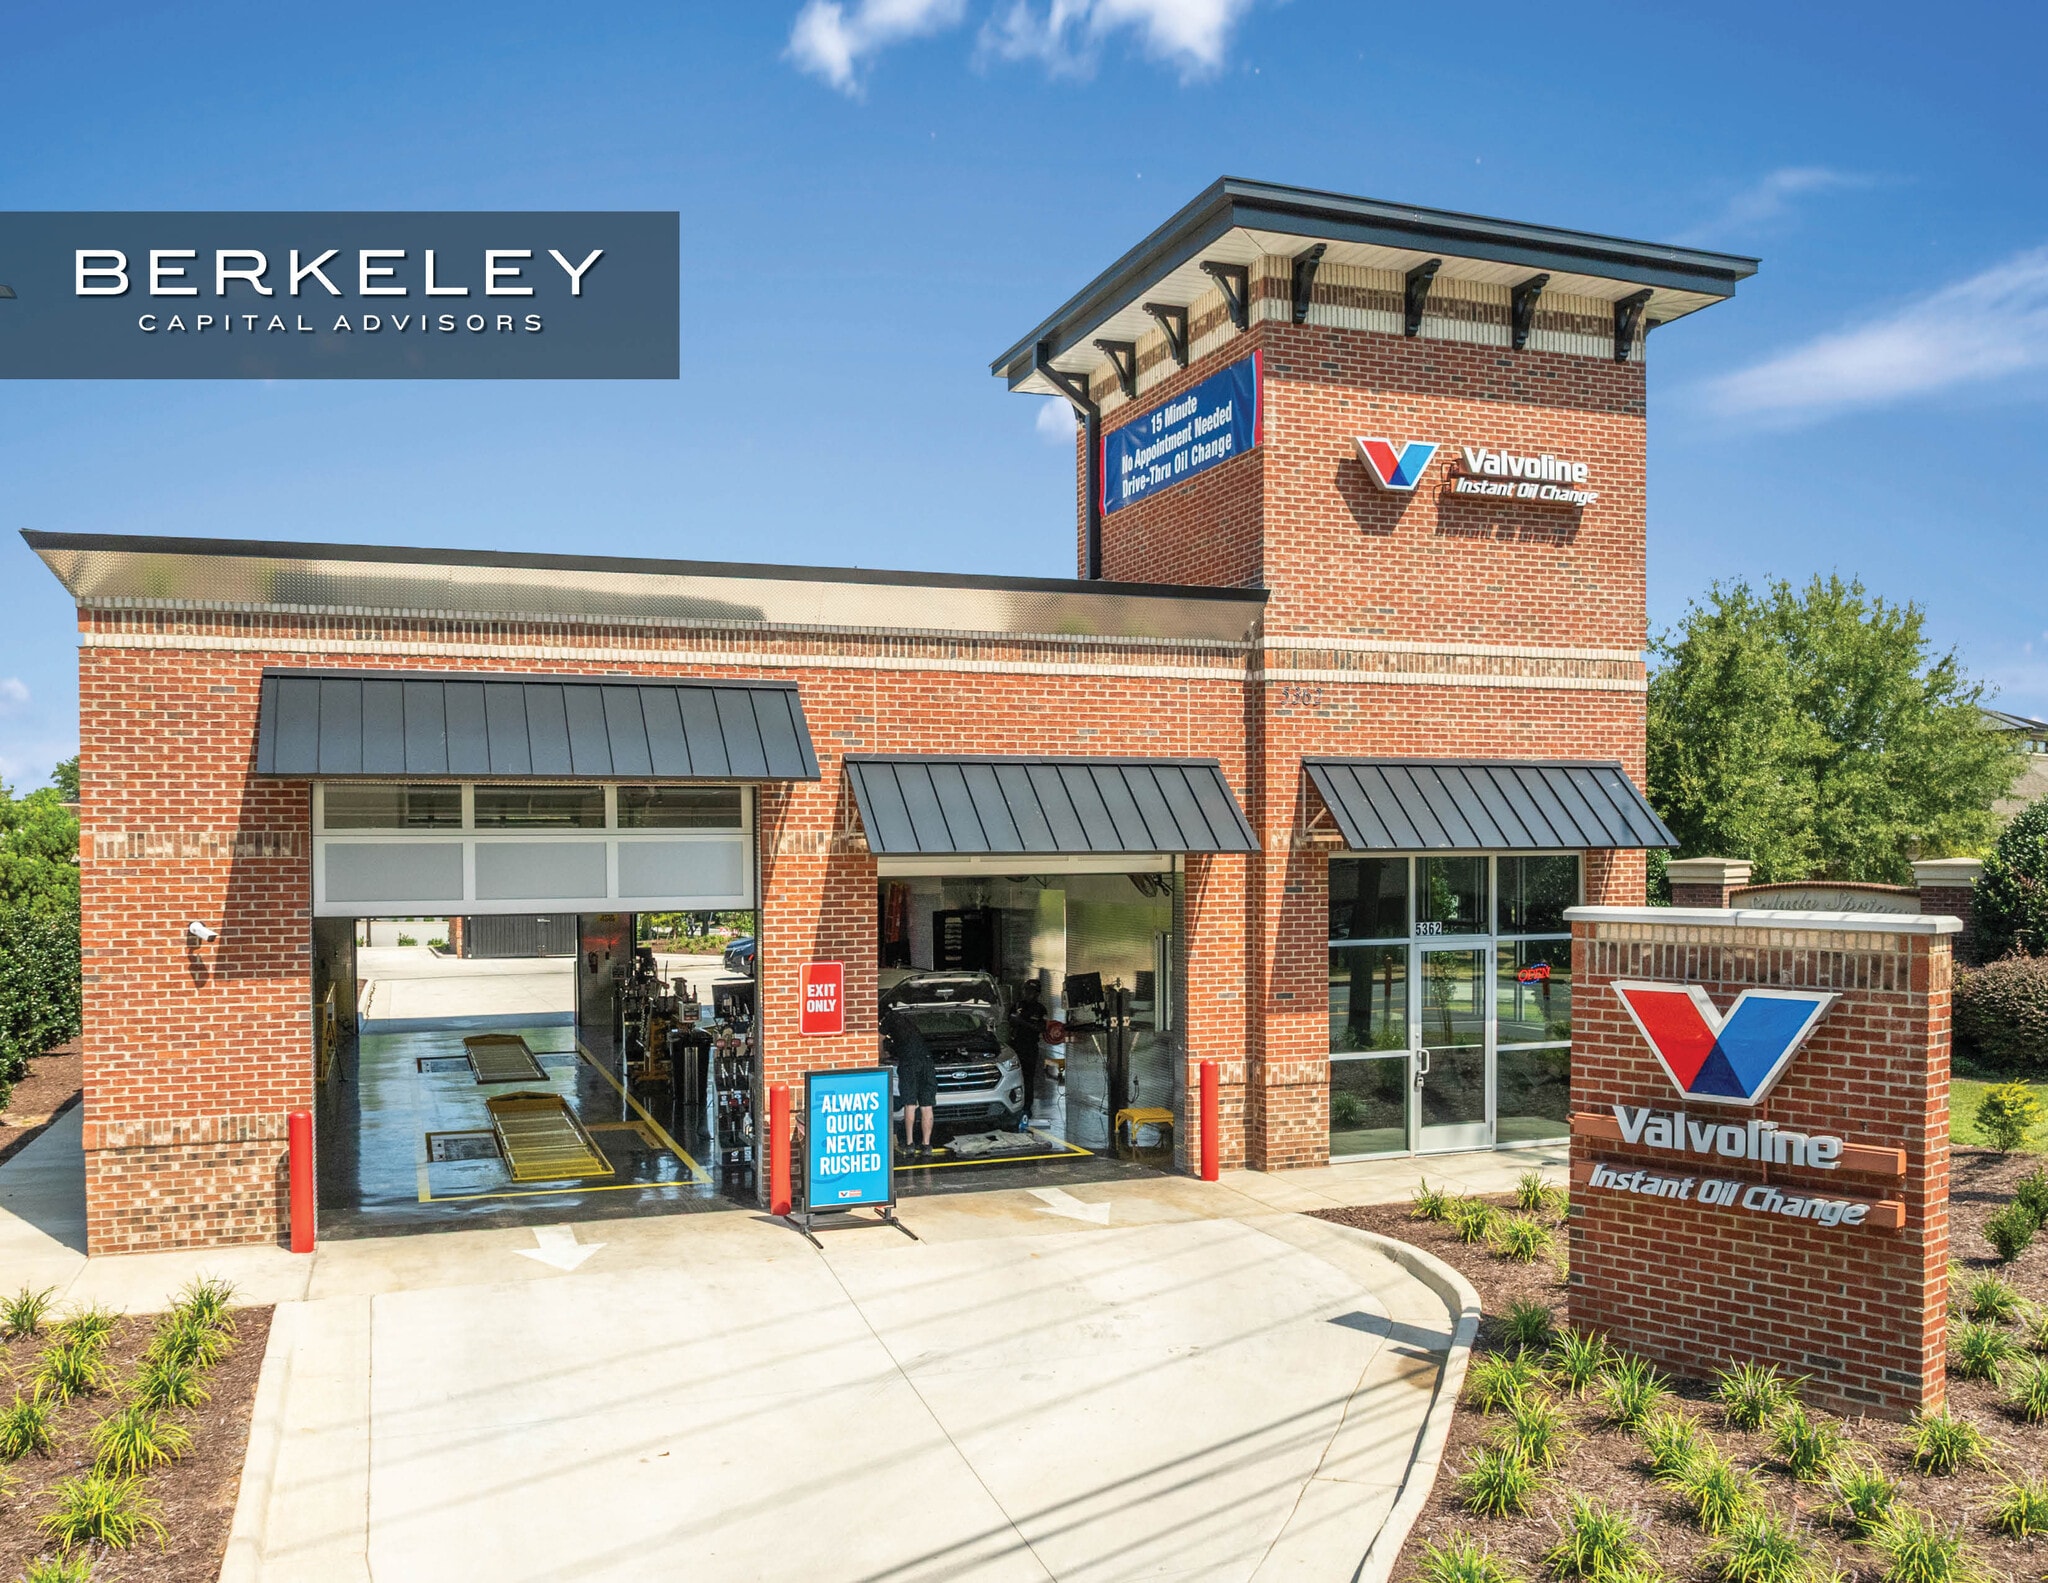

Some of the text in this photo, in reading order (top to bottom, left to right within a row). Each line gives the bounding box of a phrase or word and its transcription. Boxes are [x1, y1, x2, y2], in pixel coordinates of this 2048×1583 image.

[1151, 396, 1198, 434] 15 Minute
[1121, 400, 1232, 475] No Appointment Needed
[1122, 432, 1232, 499] Drive-Thru Oil Change
[1463, 446, 1588, 483] Valvoline
[1456, 477, 1598, 506] Instant Oil Change
[1280, 686, 1322, 706] 5362
[1415, 922, 1441, 936] 5362
[1518, 966, 1551, 982] OPEN
[807, 984, 836, 997] EXIT
[806, 999, 836, 1013] ONLY
[821, 1092, 879, 1113] ALWAYS
[825, 1113, 875, 1133] QUICK
[825, 1133, 875, 1154] NEVER
[1612, 1105, 1844, 1170] Valvoline
[819, 1153, 881, 1175] RUSHED
[1588, 1164, 1871, 1227] Instant Oil Change
